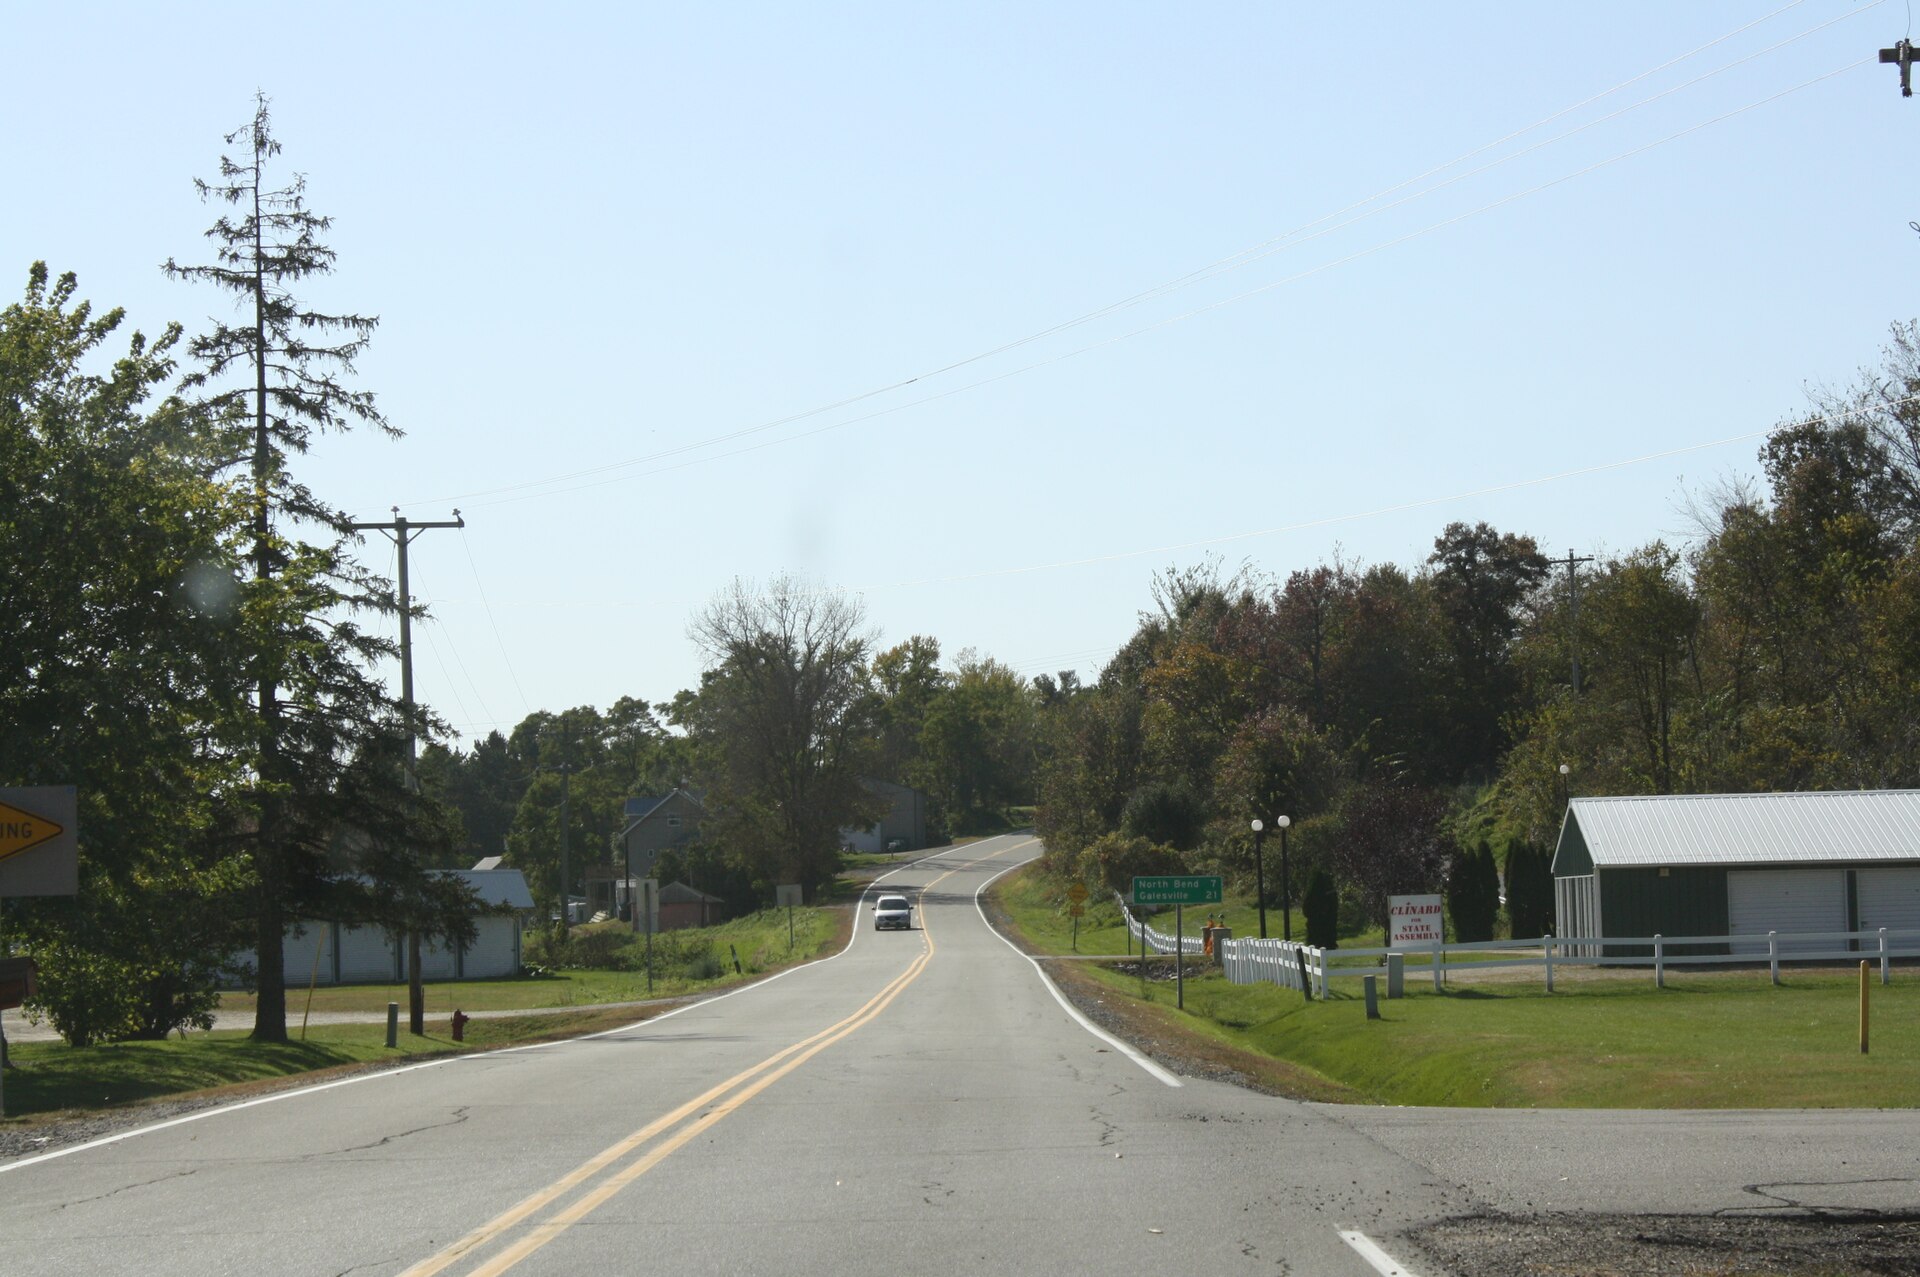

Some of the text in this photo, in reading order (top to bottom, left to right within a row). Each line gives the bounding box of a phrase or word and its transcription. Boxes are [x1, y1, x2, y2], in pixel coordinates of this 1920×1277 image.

[1138, 879, 1217, 888] North Bend 7
[1139, 891, 1217, 900] Galesville 21
[1391, 905, 1441, 915] CLINARD
[1393, 932, 1440, 941] ASSEMBLY
